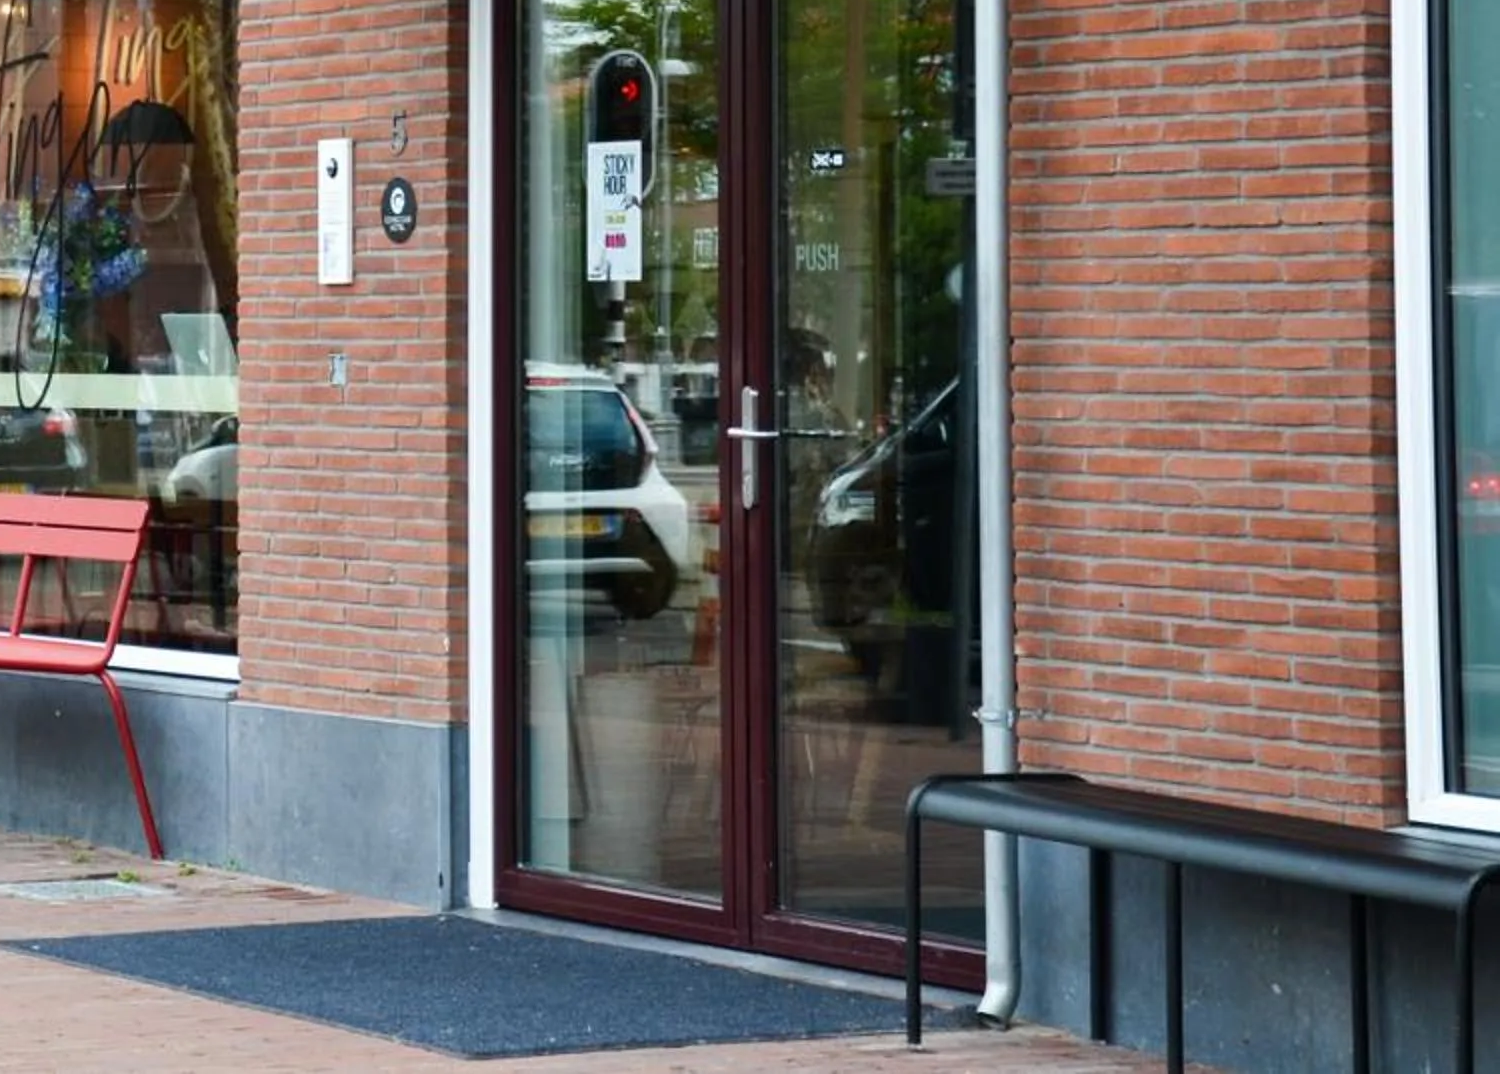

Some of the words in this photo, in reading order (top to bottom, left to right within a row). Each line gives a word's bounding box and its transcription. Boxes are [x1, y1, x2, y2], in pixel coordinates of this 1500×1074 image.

[391, 110, 408, 157] 5
[604, 176, 627, 195] HOUR
[795, 244, 839, 271] PUSH
